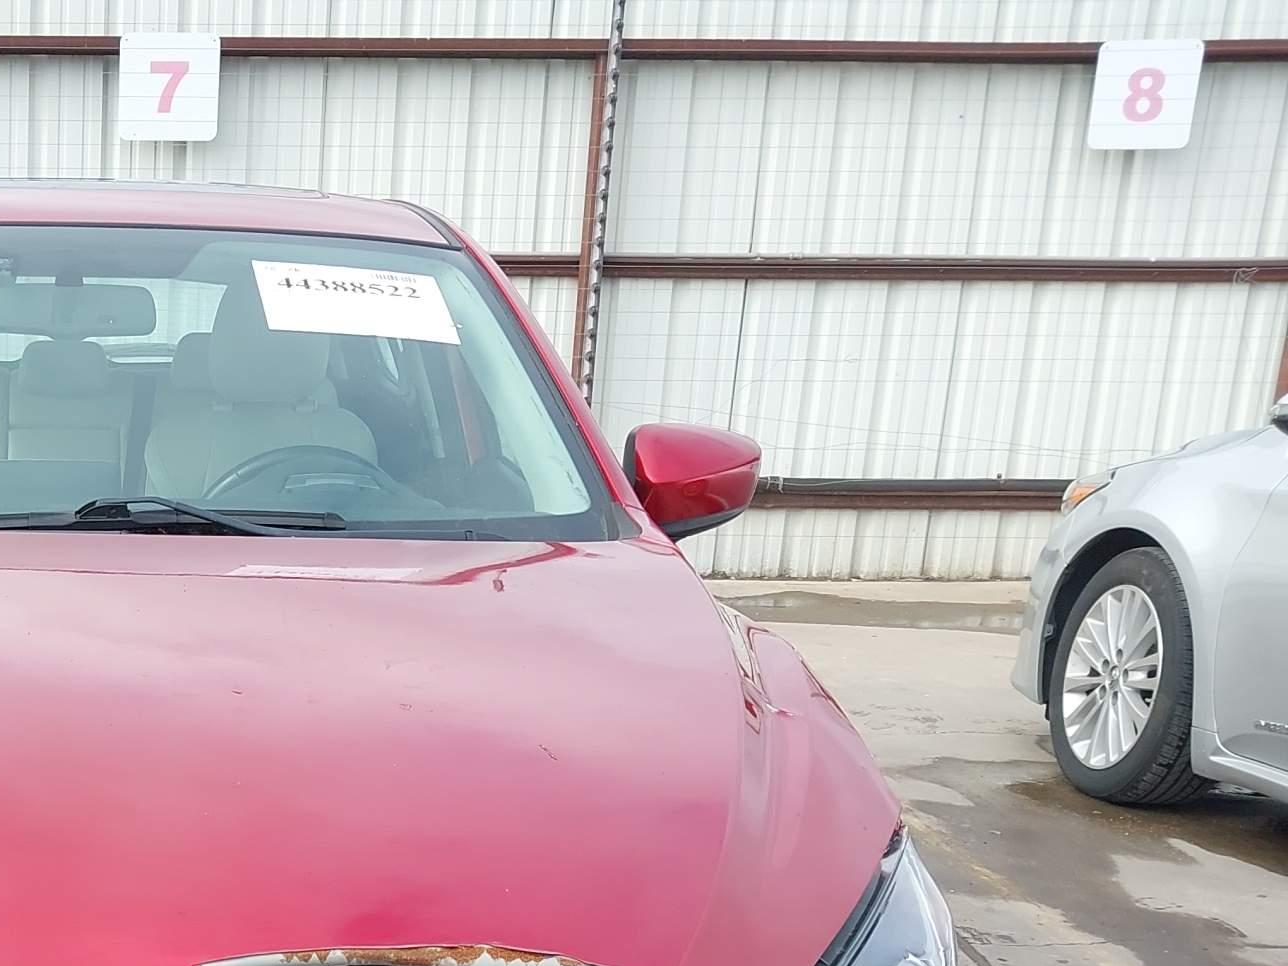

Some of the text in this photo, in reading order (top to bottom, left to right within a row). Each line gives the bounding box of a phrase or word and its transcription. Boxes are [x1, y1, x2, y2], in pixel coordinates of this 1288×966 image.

[150, 61, 189, 113] 7
[1122, 67, 1166, 122] 8
[277, 277, 422, 299] 44388522
